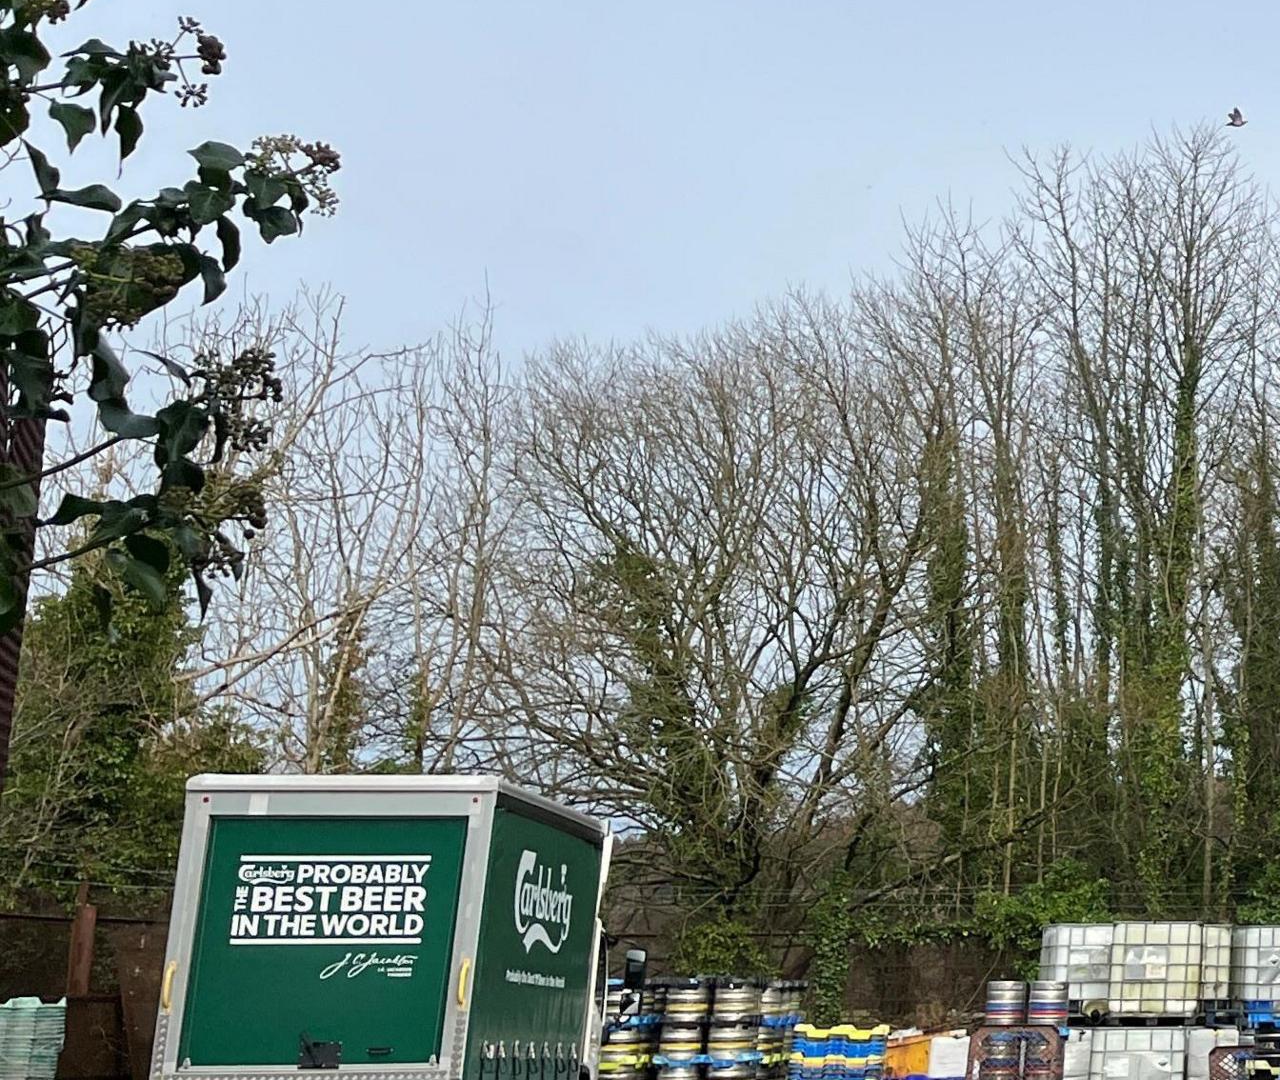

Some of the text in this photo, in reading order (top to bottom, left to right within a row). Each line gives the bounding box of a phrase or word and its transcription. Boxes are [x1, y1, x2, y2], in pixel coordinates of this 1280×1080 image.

[238, 864, 430, 885] Carlsberg PROBABLY
[233, 886, 250, 912] THE
[250, 886, 427, 913] BEST BEER
[514, 849, 573, 954] Carlsberg
[230, 914, 425, 937] IN THE WORLD
